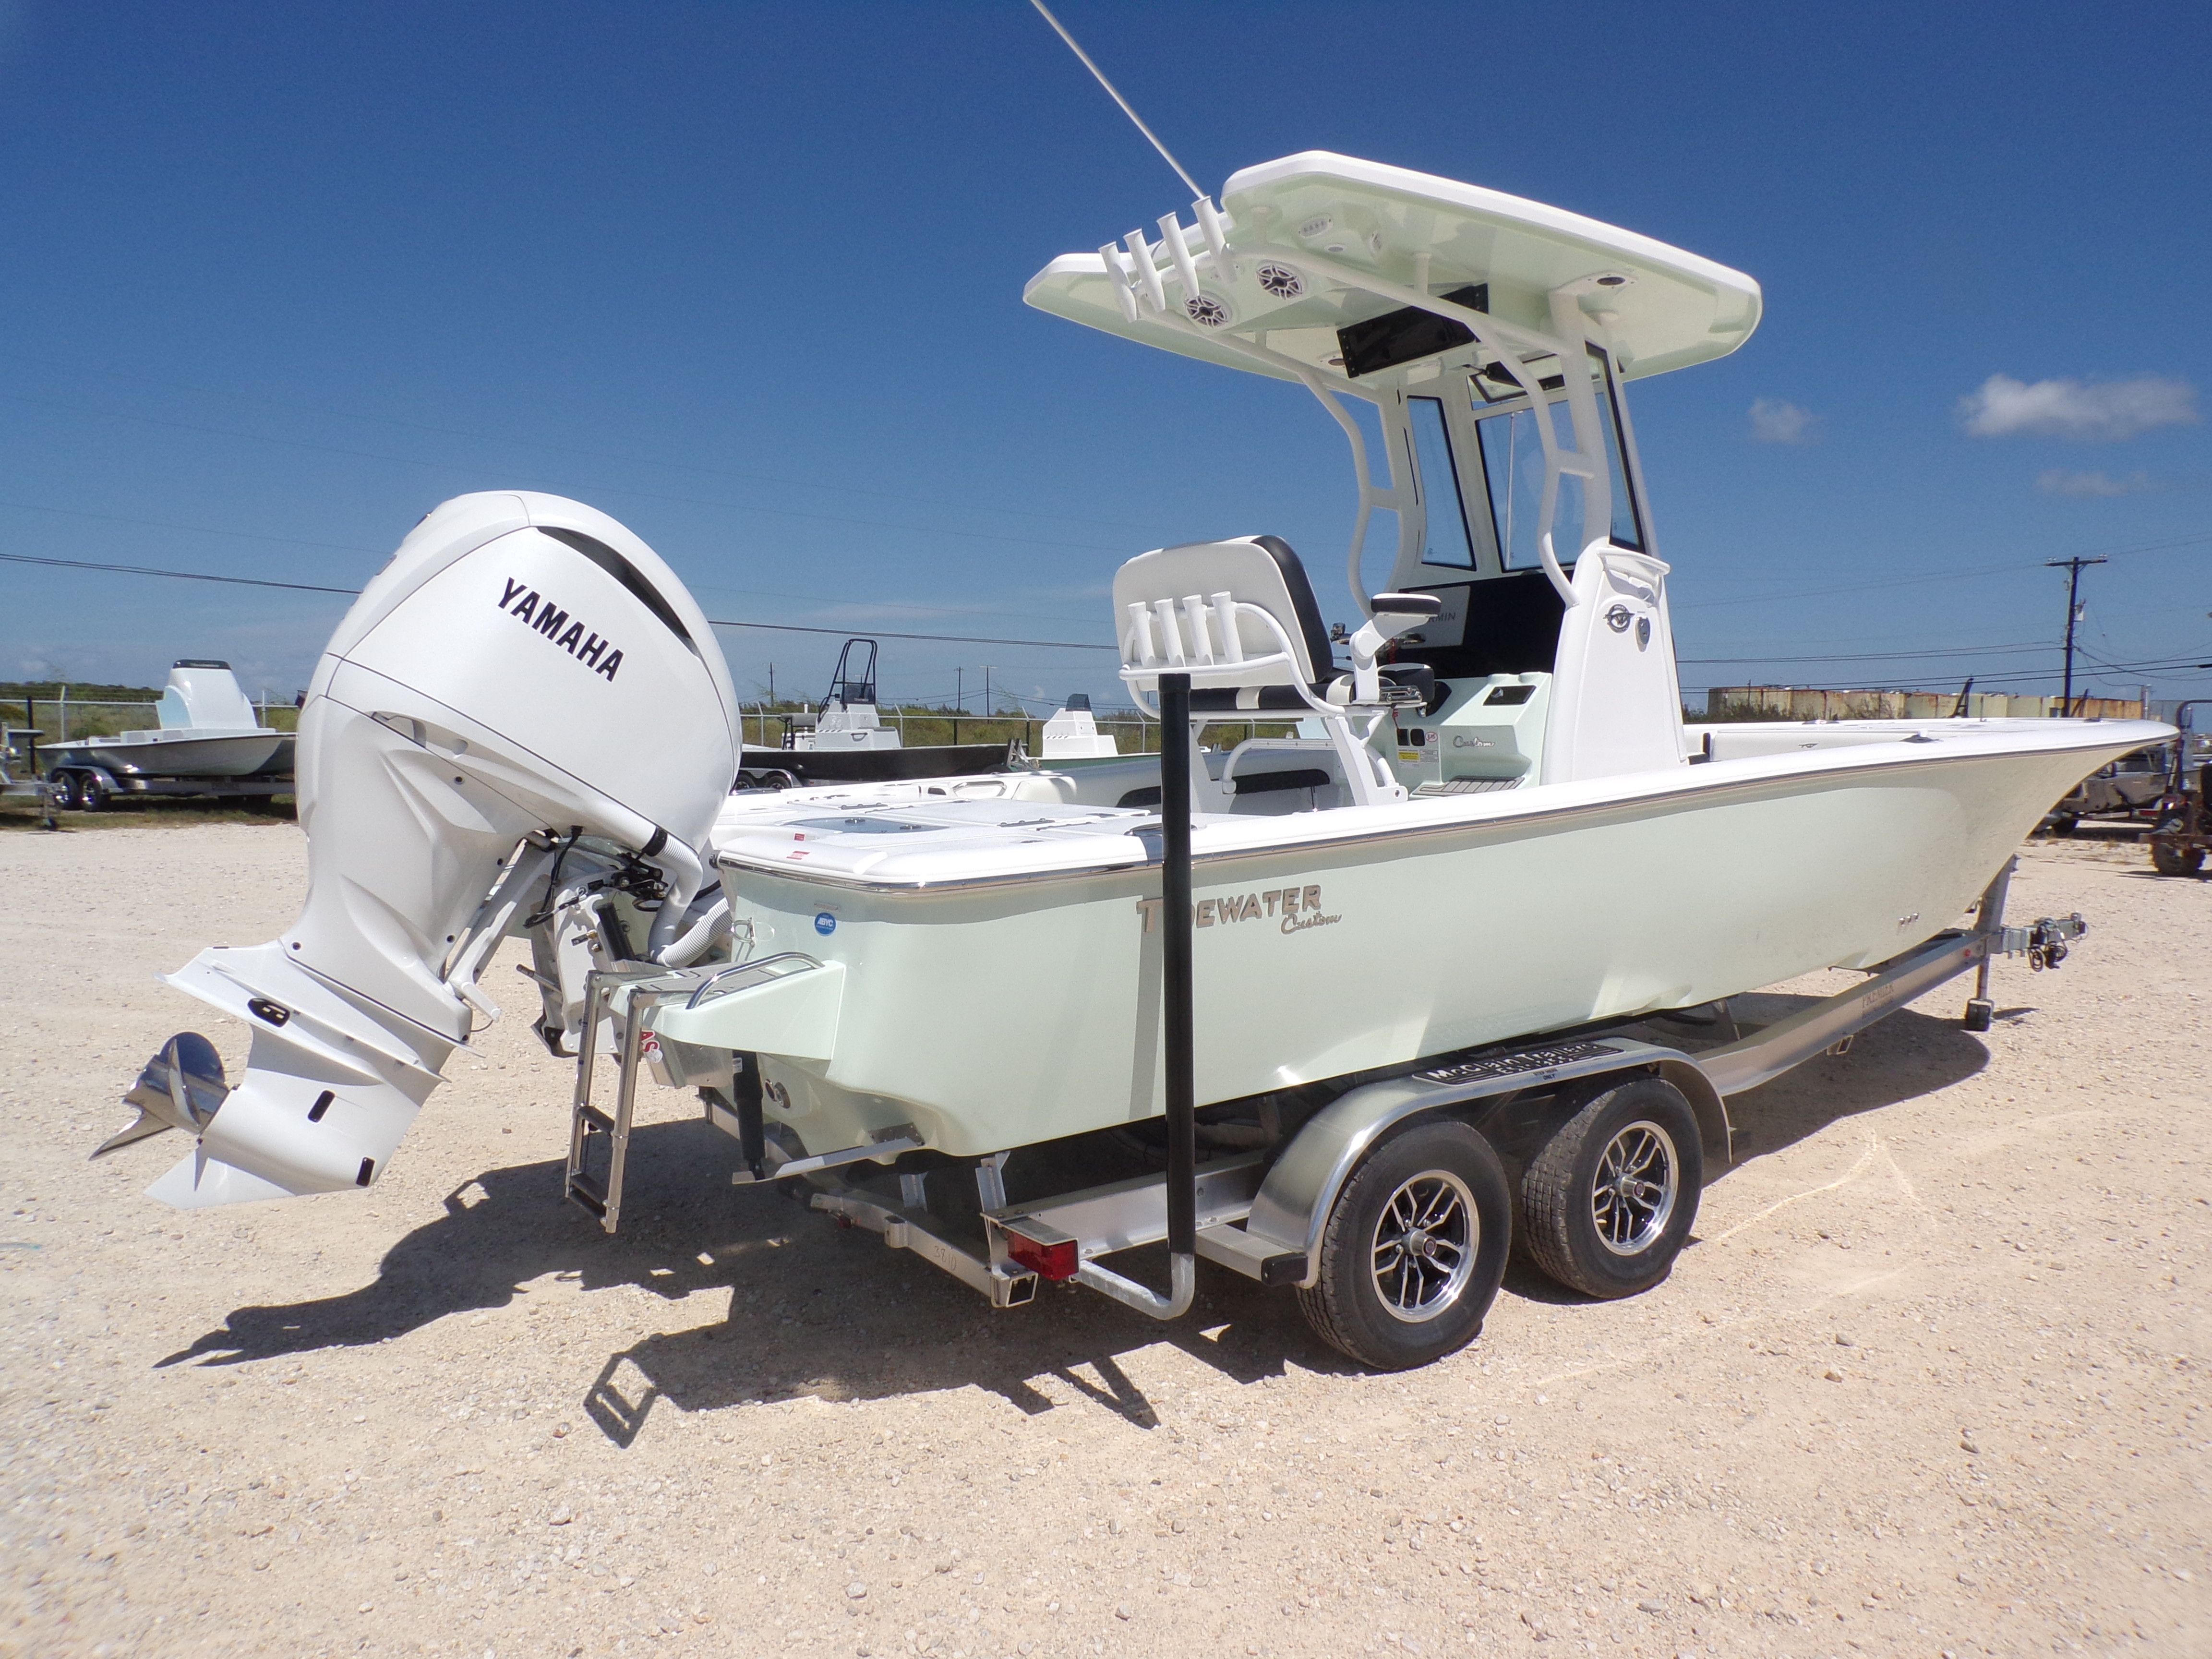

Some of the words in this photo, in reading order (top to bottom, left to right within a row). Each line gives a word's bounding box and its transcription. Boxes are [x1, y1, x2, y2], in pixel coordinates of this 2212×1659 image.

[497, 577, 625, 683] YAMAHA
[1136, 884, 1321, 933] TEWATER
[1281, 911, 1342, 935] Custom
[1426, 1058, 1521, 1079] McClain
[1515, 1044, 1598, 1061] Trailers
